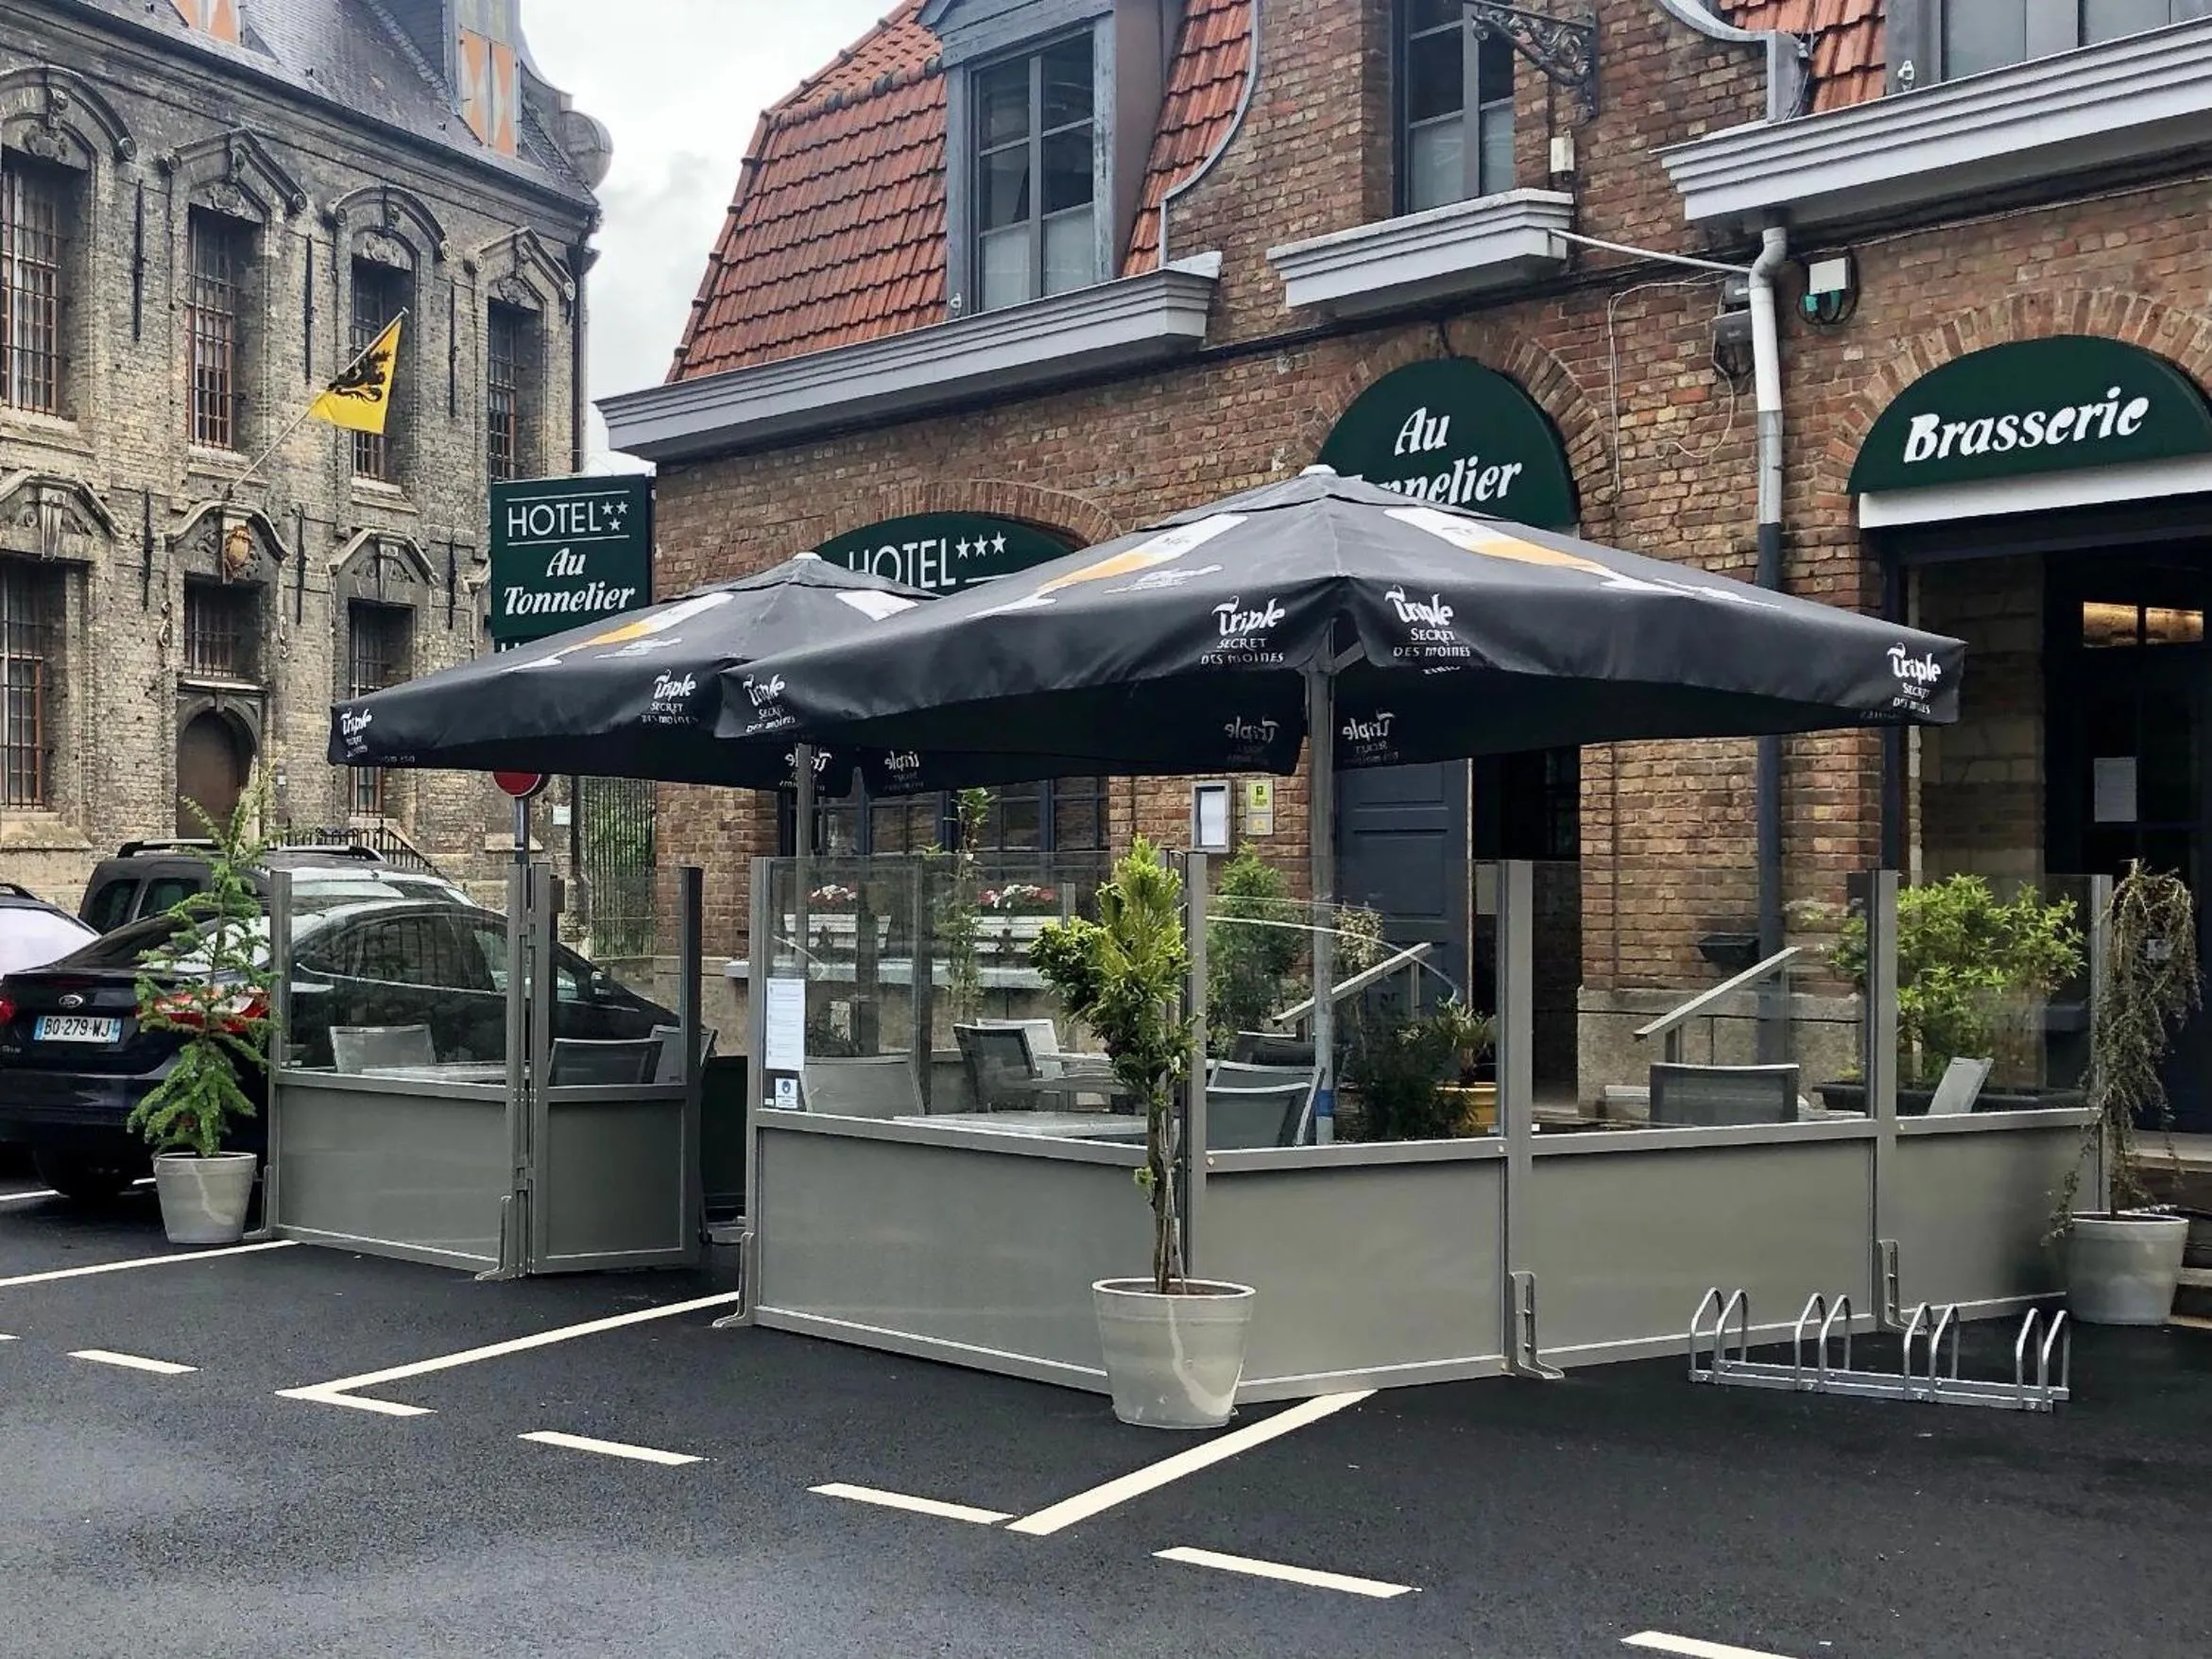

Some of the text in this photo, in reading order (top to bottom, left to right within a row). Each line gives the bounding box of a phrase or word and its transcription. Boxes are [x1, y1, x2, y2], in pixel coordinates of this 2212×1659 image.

[1394, 406, 1450, 456] Au
[1903, 385, 2150, 463] Brasserie
[1339, 455, 1522, 505] nelier
[507, 501, 602, 538] HOTEL
[545, 547, 587, 577] Au
[849, 537, 956, 589] HOTEL
[504, 580, 636, 615] Tonnelier
[1211, 595, 1285, 636] Triple
[1384, 584, 1454, 628] Triple
[1216, 638, 1267, 651] SECRET
[1393, 646, 1420, 657] DES
[1410, 628, 1456, 645] SECRET
[1201, 654, 1224, 665] DES
[1886, 641, 1942, 685] Triple
[654, 669, 697, 701] Triple
[743, 674, 786, 707] Triple
